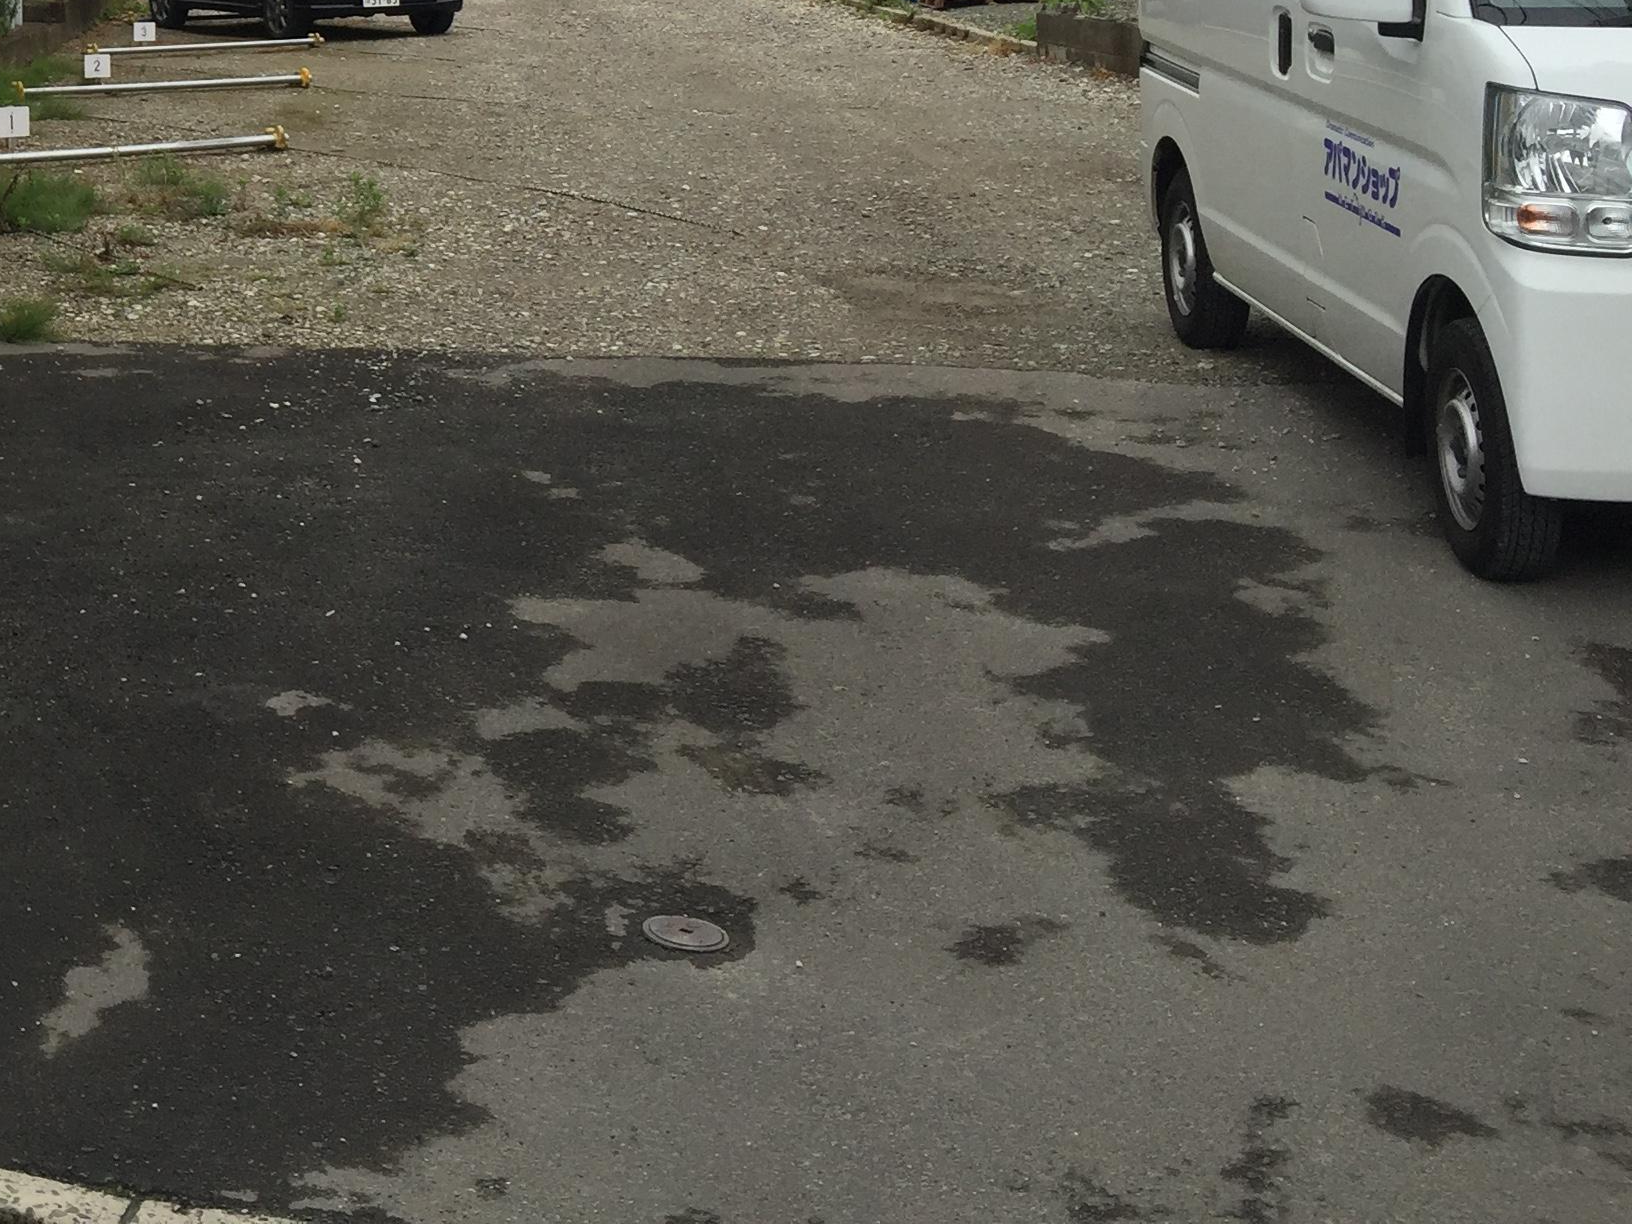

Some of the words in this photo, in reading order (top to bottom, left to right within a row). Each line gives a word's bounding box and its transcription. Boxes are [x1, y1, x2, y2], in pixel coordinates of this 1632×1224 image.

[140, 26, 147, 37] 3
[93, 60, 101, 72] 2
[1324, 137, 1401, 208] アパマンショップ
